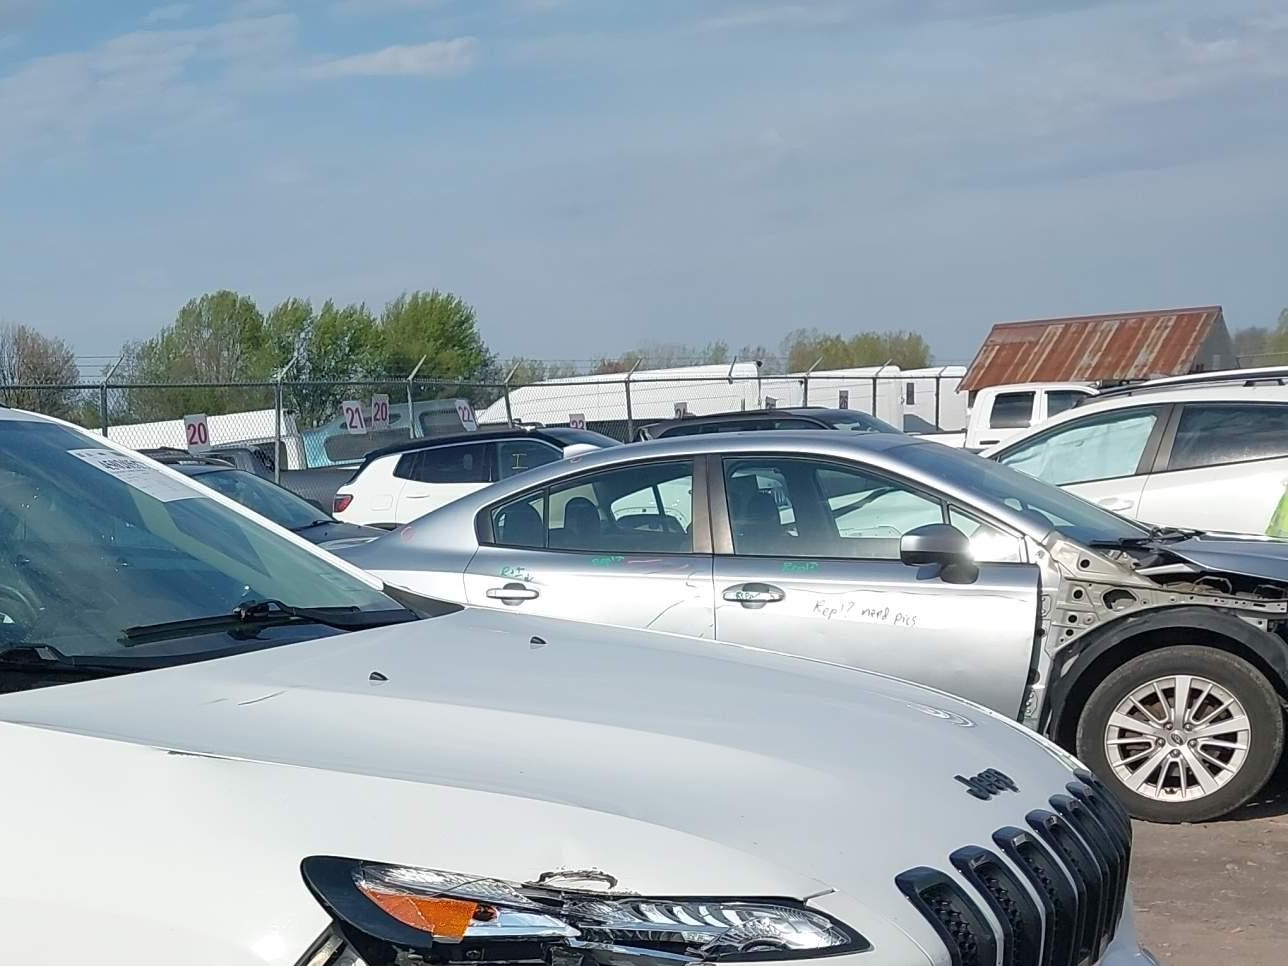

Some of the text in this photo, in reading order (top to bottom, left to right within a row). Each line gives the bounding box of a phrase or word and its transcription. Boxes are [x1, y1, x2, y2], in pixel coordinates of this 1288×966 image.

[346, 407, 364, 429] 21
[373, 402, 388, 422] 20
[187, 422, 207, 445] 20
